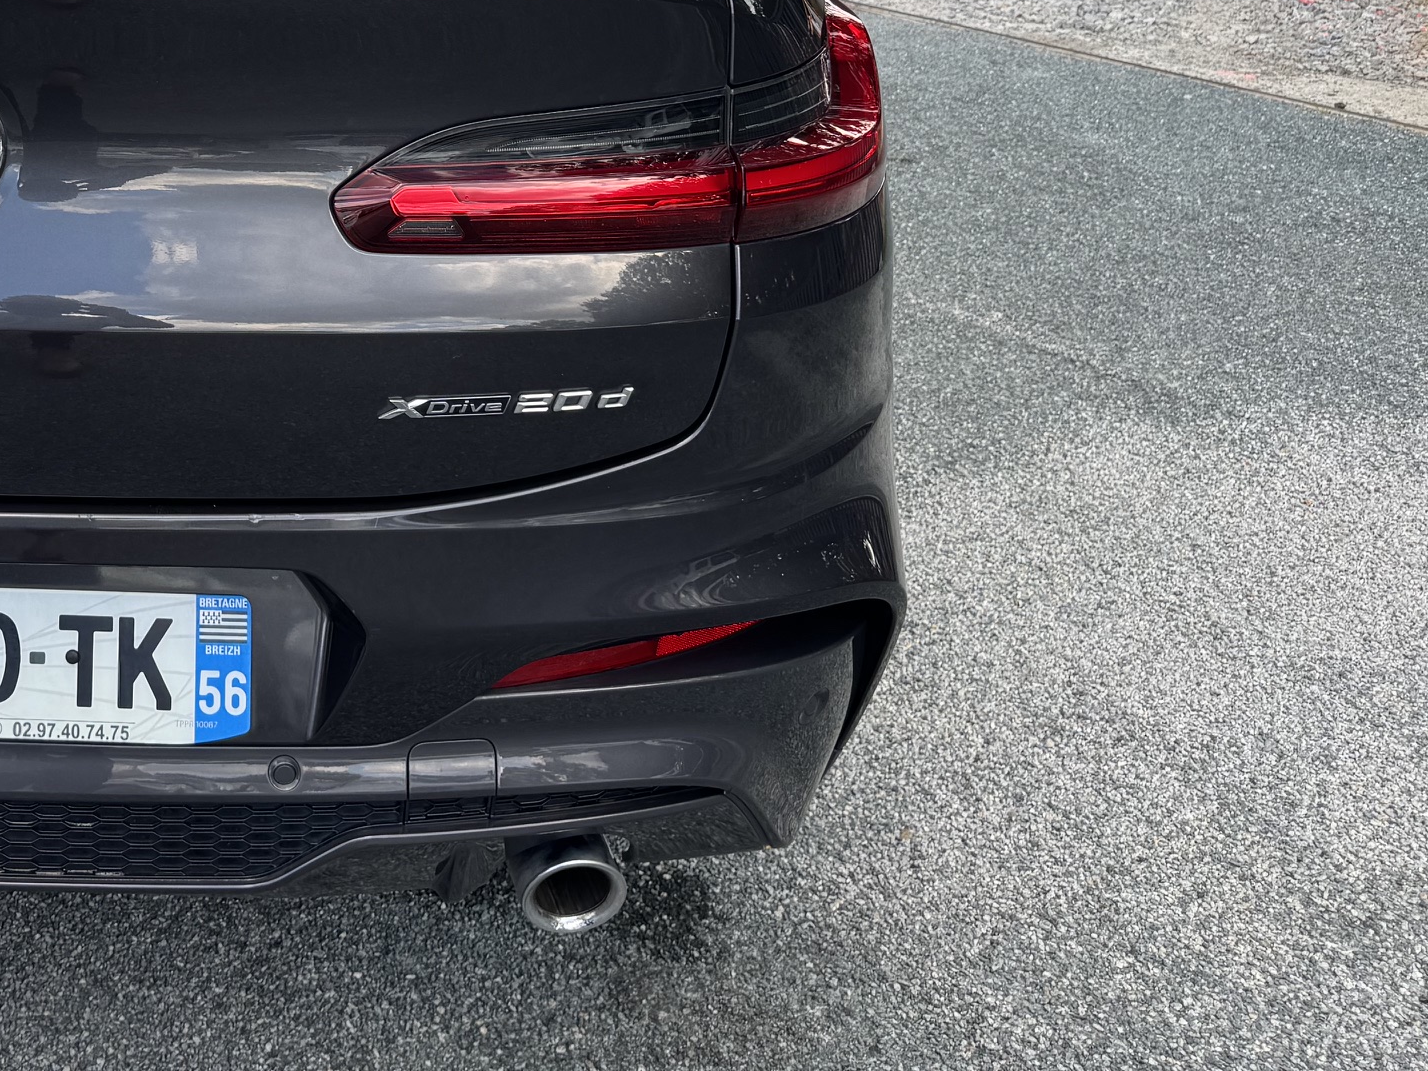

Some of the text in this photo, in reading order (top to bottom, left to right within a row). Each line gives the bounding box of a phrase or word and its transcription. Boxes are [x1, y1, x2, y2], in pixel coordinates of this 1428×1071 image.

[199, 597, 248, 609] BRETAGNE
[205, 644, 241, 656] BREIZH
[198, 670, 247, 716] 56
[12, 721, 130, 741] 02.97.40.74.75
